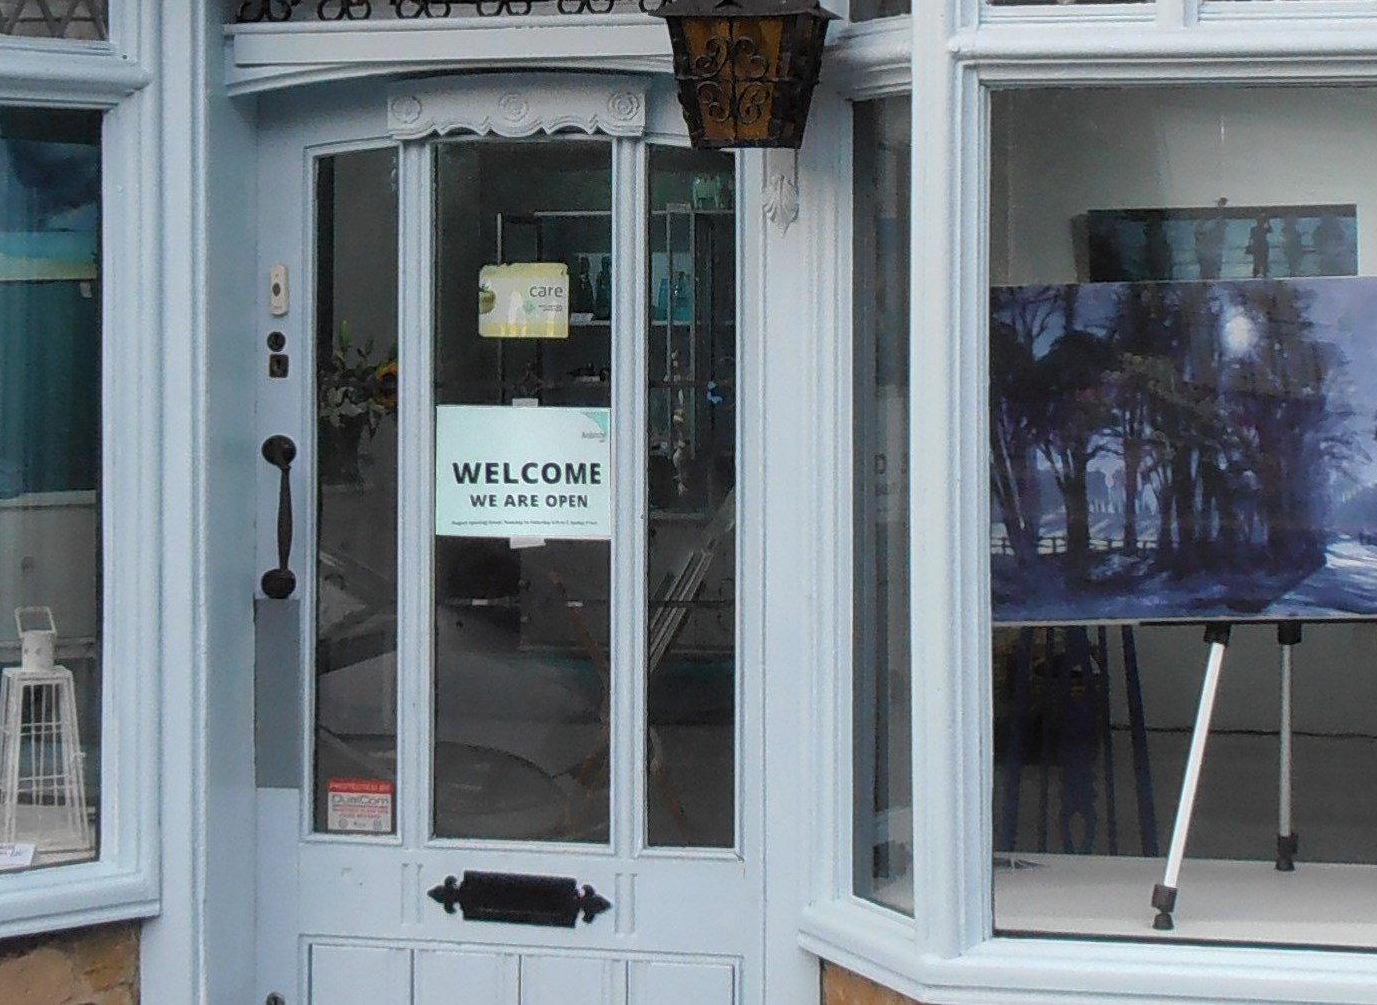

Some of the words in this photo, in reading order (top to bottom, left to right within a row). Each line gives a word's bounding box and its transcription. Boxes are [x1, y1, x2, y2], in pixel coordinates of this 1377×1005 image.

[529, 285, 564, 298] care
[451, 461, 602, 485] WELCOME
[470, 494, 497, 508] WE
[503, 494, 539, 508] ARE
[545, 494, 589, 508] OPEN
